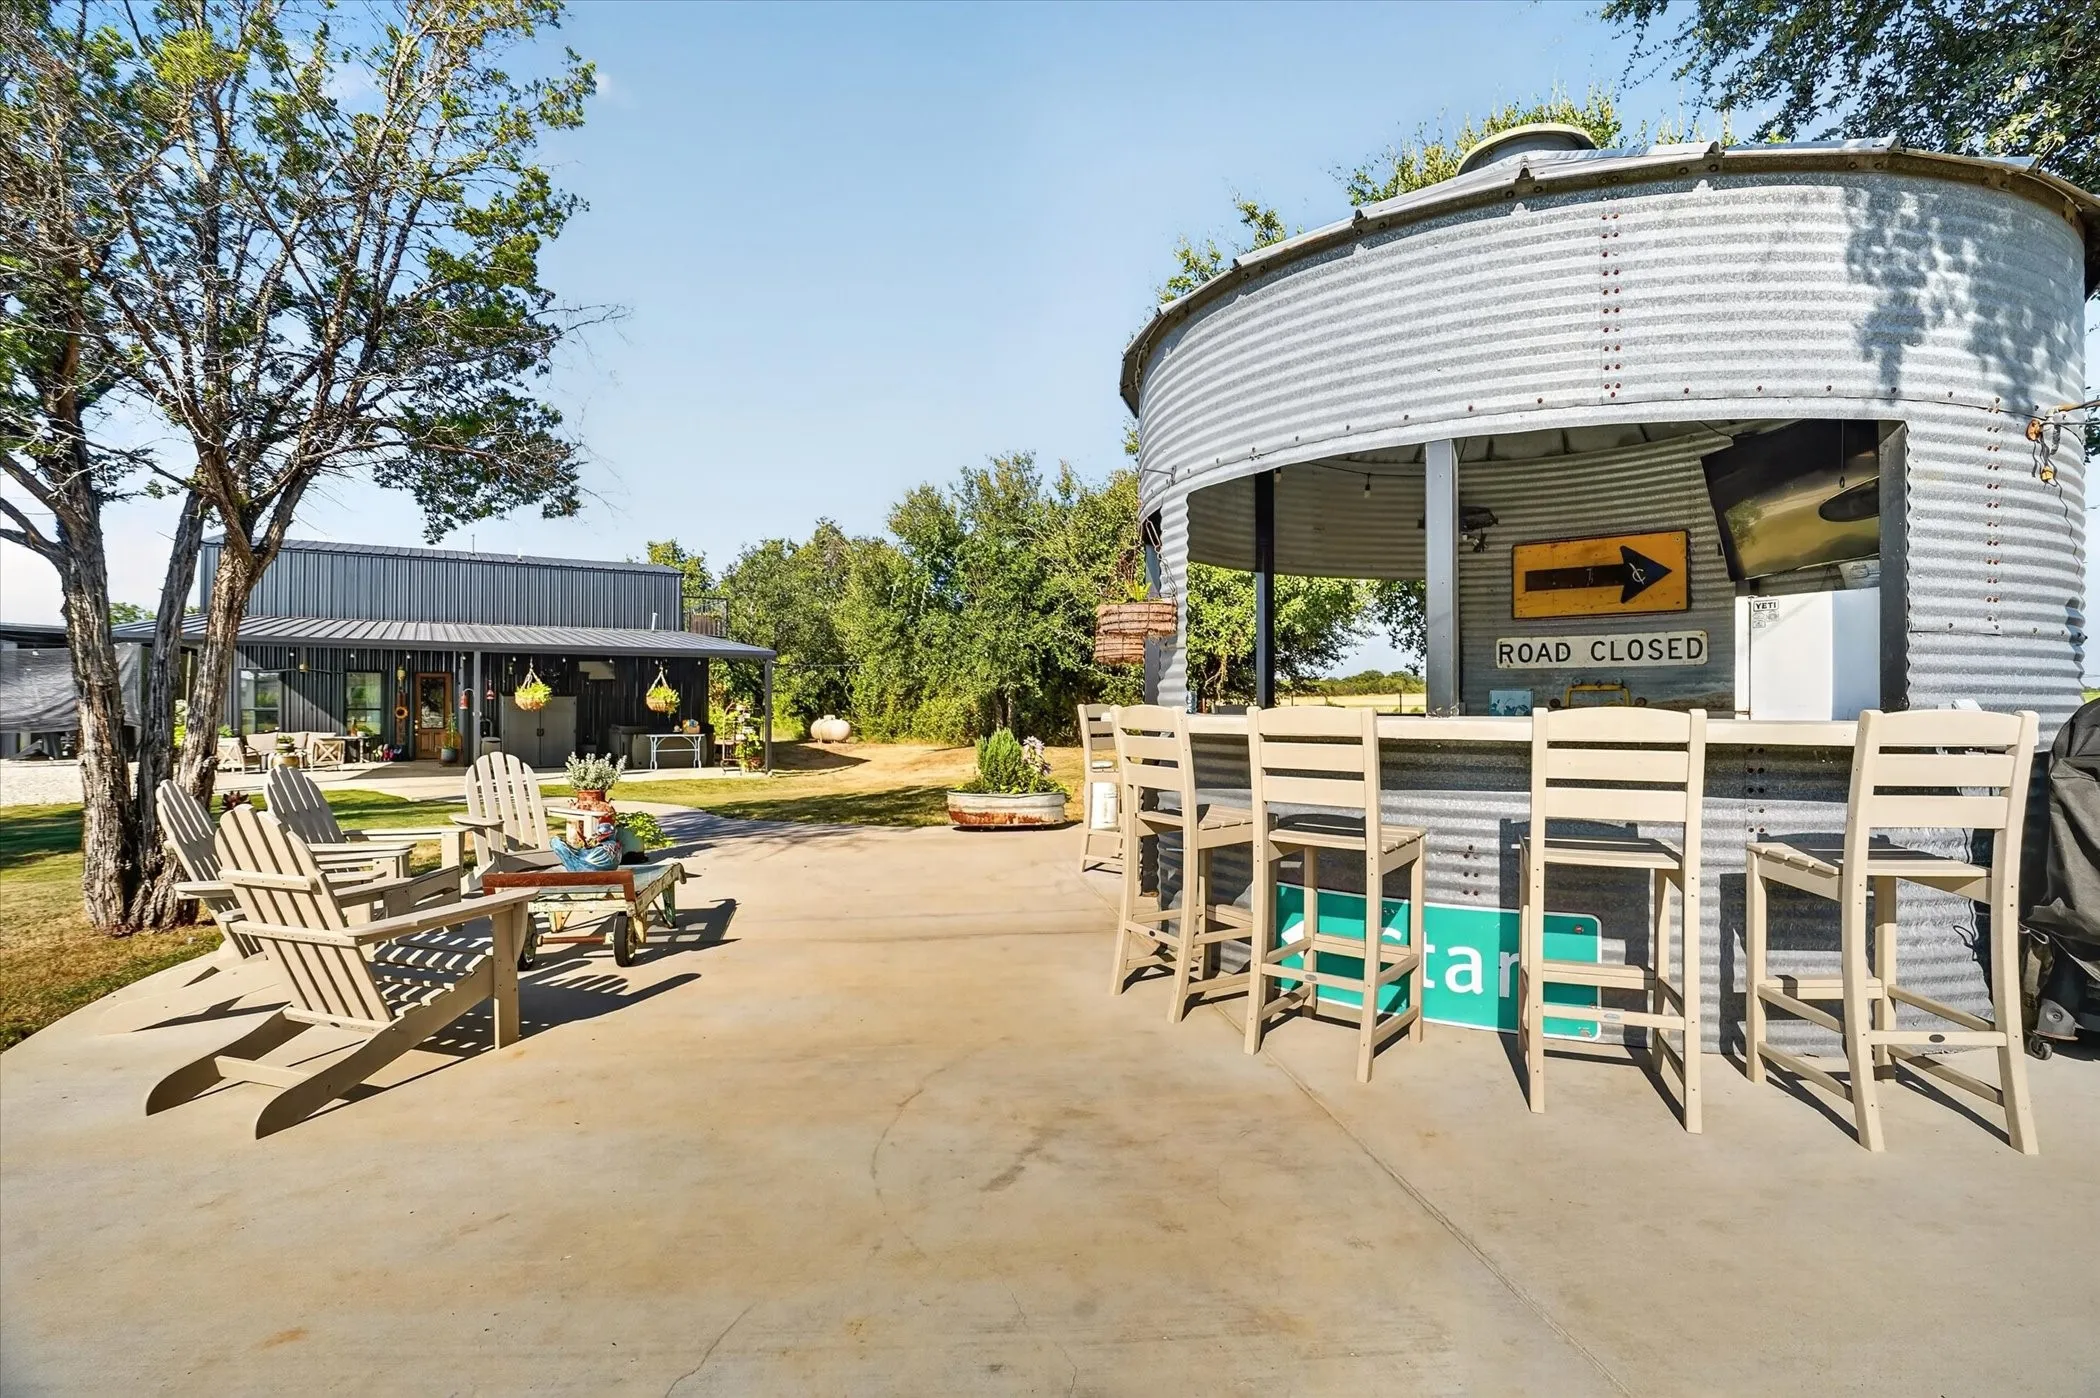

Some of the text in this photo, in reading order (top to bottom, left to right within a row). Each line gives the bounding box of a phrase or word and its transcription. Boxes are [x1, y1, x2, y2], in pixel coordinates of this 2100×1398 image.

[1755, 601, 1777, 610] YETI
[1499, 637, 1704, 664] ROAD CLOSED
